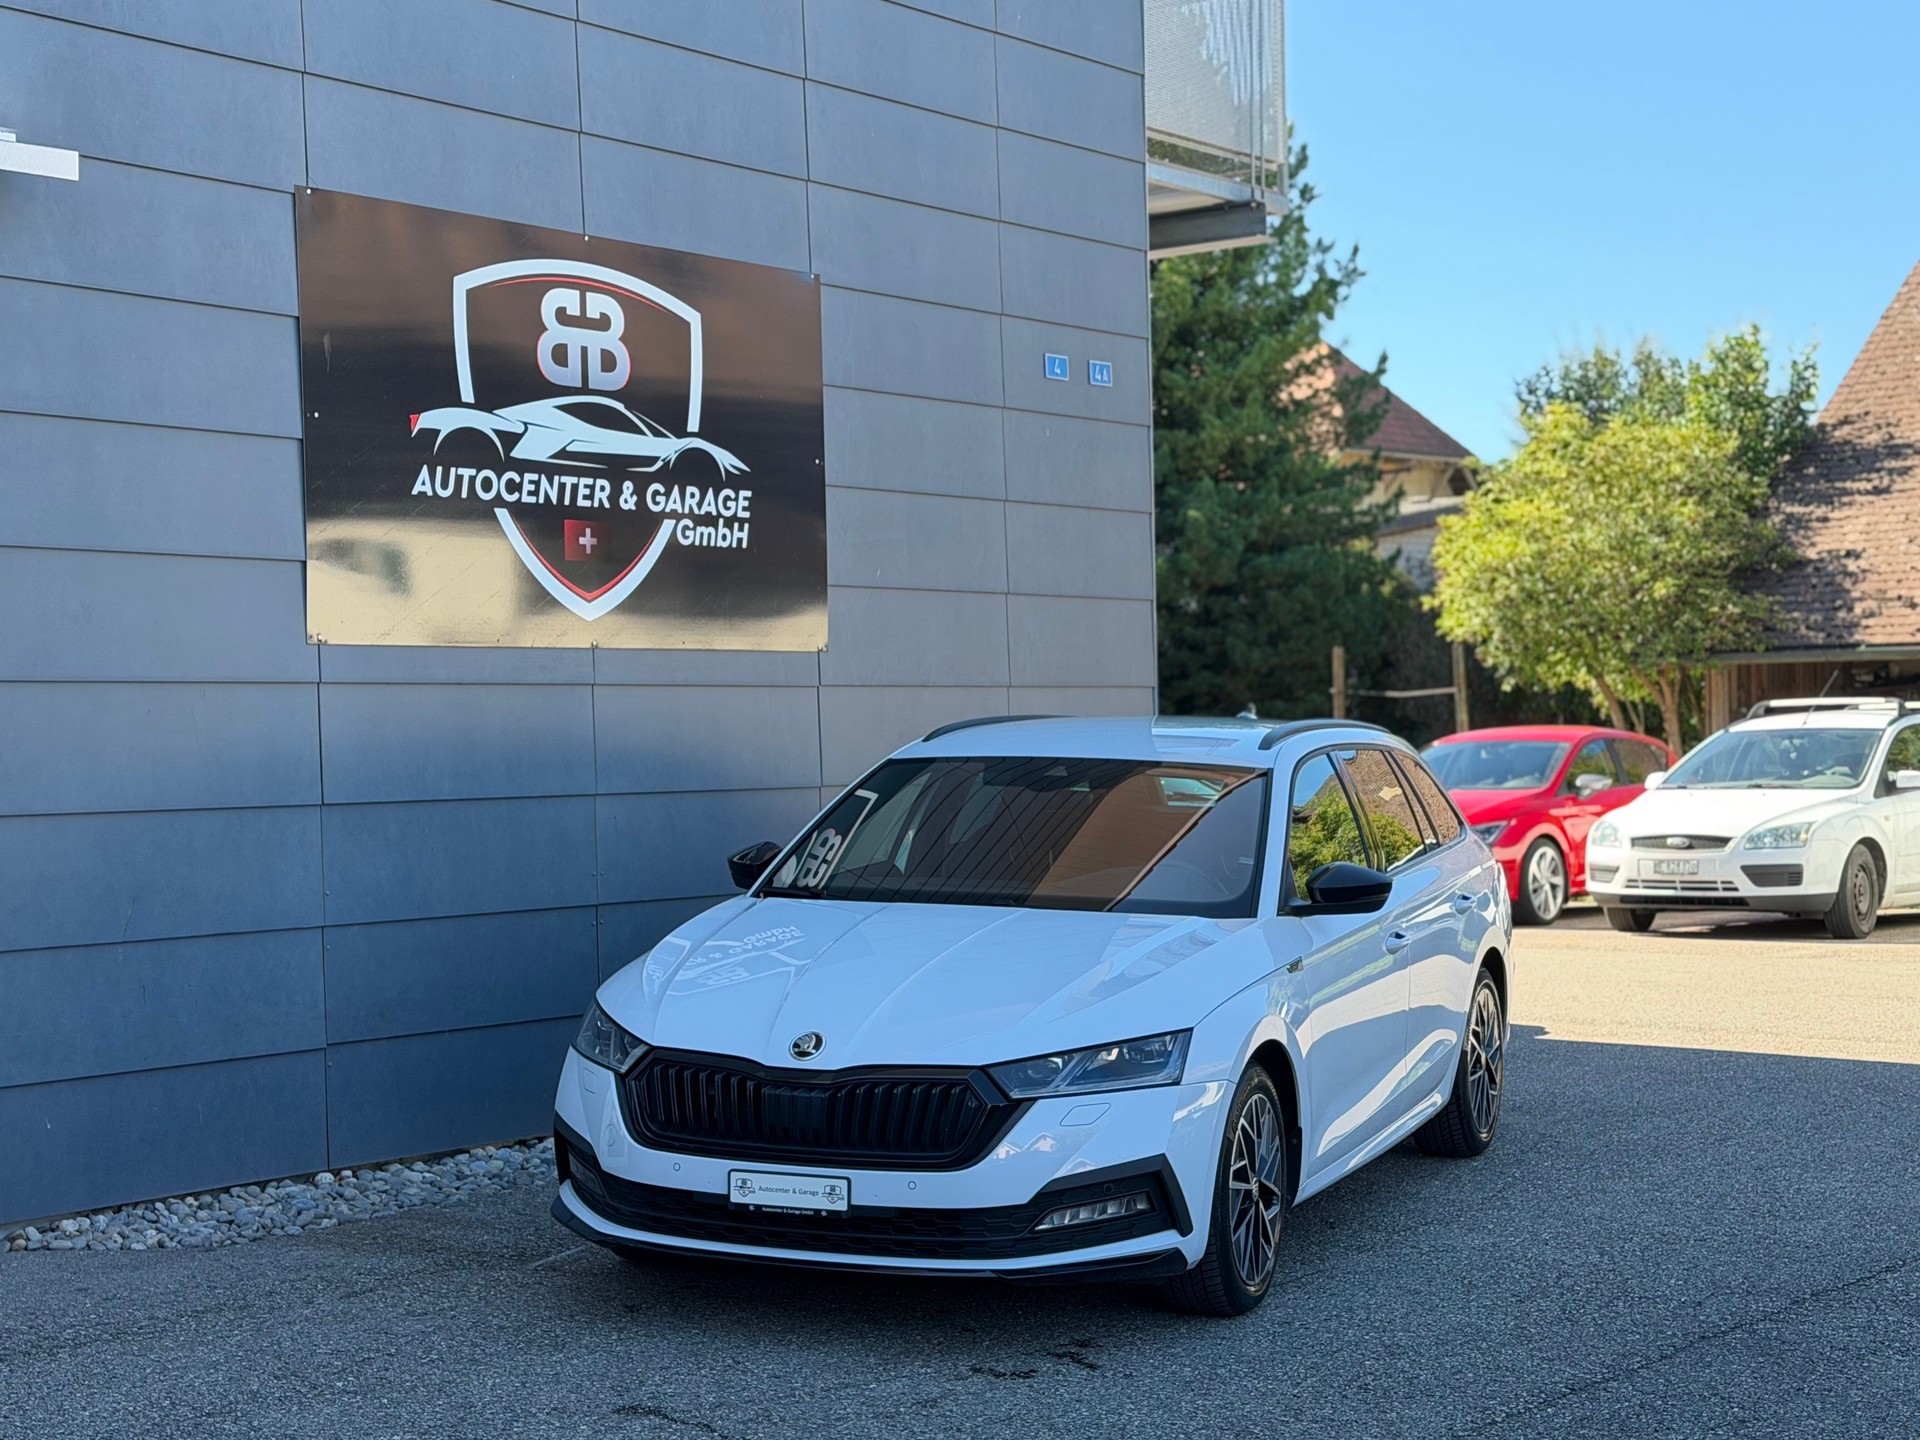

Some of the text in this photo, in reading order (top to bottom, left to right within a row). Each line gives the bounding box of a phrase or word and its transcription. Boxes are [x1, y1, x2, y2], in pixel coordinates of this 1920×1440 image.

[1054, 358, 1061, 375] 4
[411, 464, 752, 518] AUTOCENTER & GARAGE
[676, 518, 749, 549] GmbH
[758, 1185, 790, 1194] Autocenter
[798, 1188, 819, 1197] Garage
